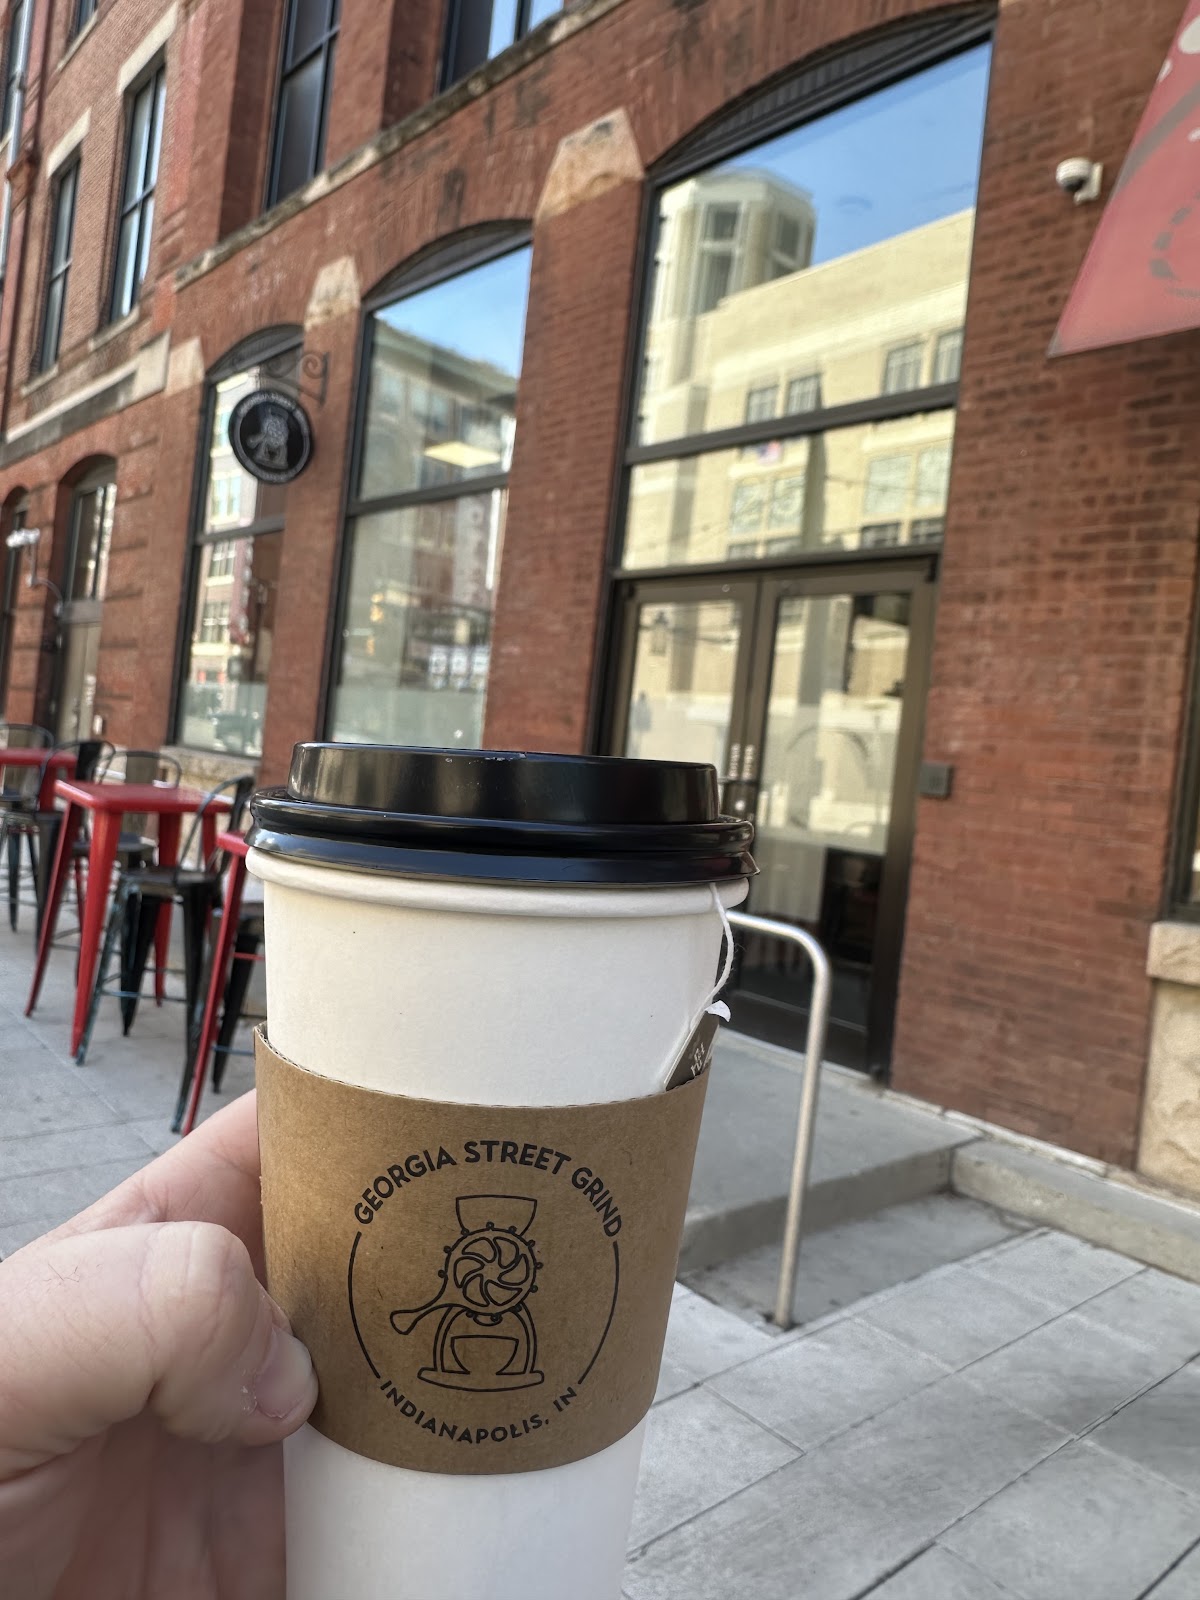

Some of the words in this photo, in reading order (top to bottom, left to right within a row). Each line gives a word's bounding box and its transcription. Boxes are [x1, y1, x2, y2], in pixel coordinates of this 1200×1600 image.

[354, 1146, 457, 1224] GEORGIA
[463, 1140, 572, 1175] STREET
[571, 1167, 622, 1238] GRIND
[553, 1386, 578, 1412] IN
